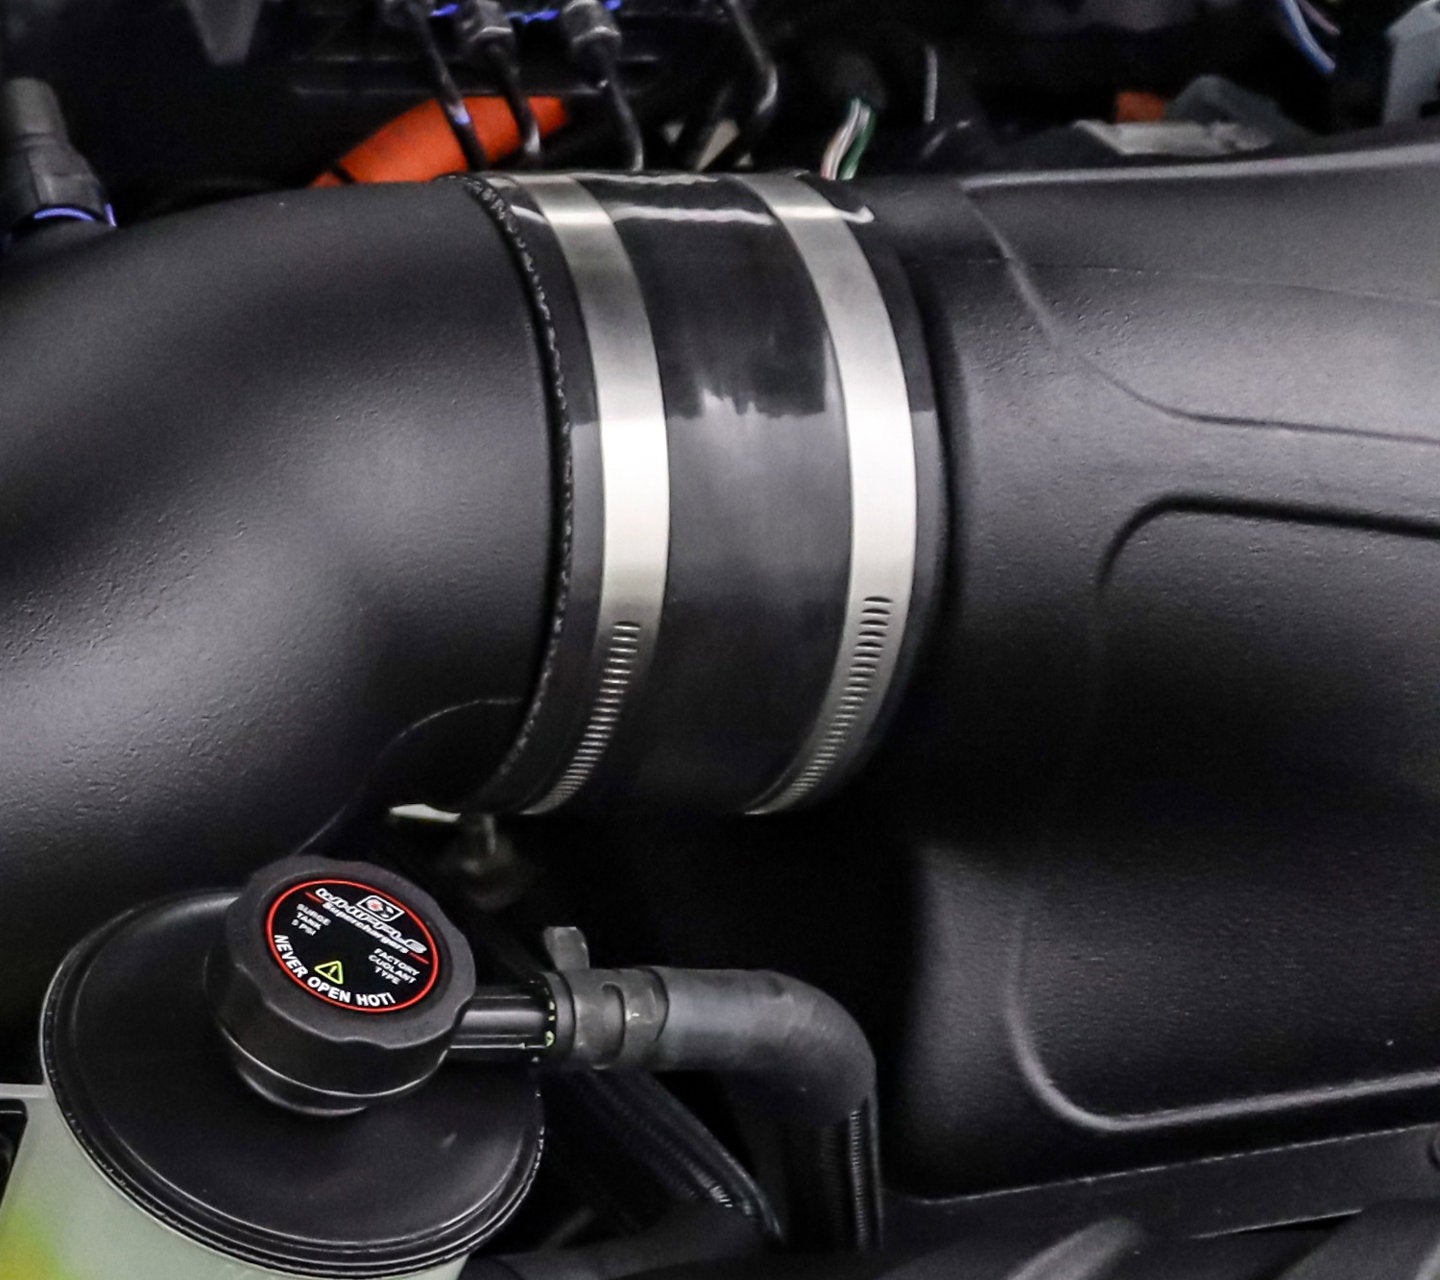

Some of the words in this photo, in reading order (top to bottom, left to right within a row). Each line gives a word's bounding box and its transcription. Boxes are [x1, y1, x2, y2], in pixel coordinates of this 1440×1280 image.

[315, 888, 427, 953] WHIPPLE
[274, 935, 308, 978] NEVER
[373, 948, 420, 976] FACTORY
[375, 966, 400, 985] TYPE
[307, 976, 351, 1003] OPEN
[356, 992, 396, 1006] HOT!
